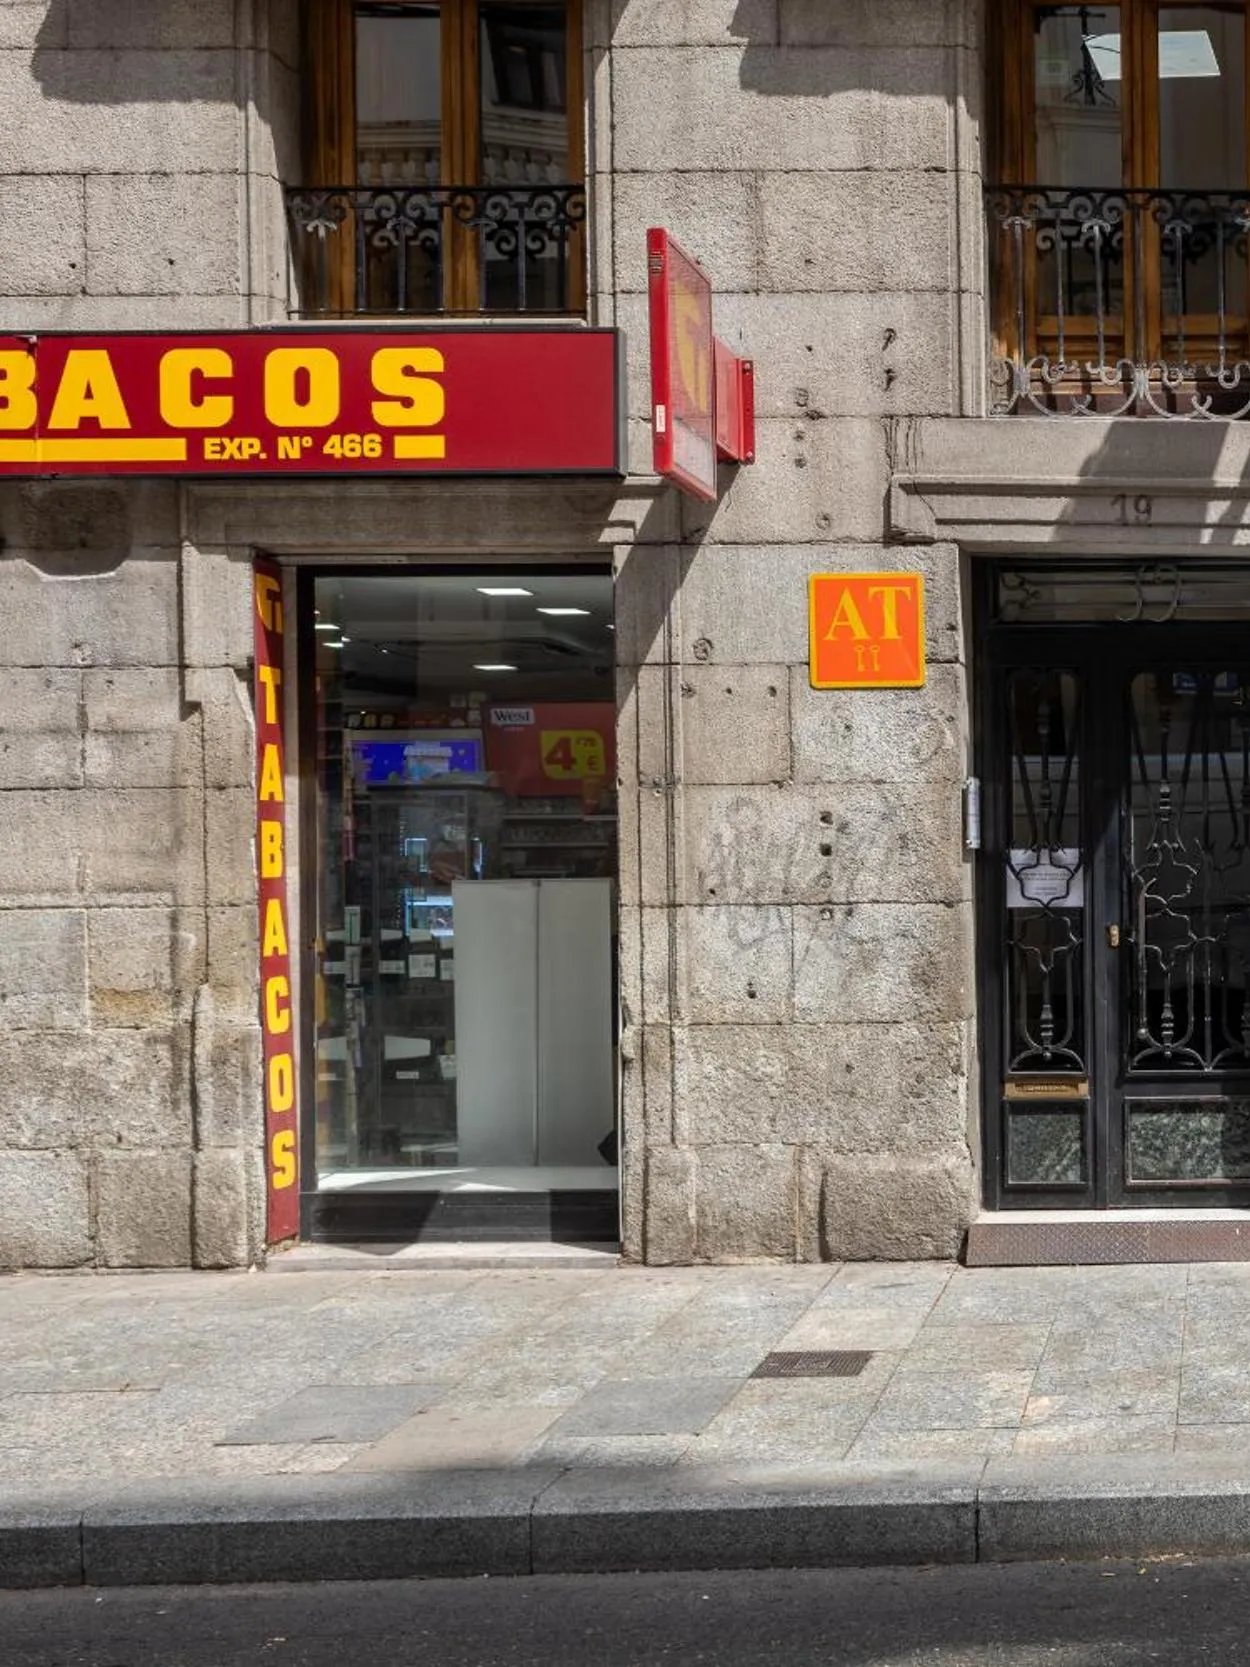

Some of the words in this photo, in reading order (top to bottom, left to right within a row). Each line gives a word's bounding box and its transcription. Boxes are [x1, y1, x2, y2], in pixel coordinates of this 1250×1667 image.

[203, 437, 268, 461] EXP.
[322, 433, 383, 459] 466
[1110, 493, 1153, 527] 19
[823, 585, 912, 641] AT
[494, 710, 530, 722] West
[258, 665, 295, 1190] TABACOS
